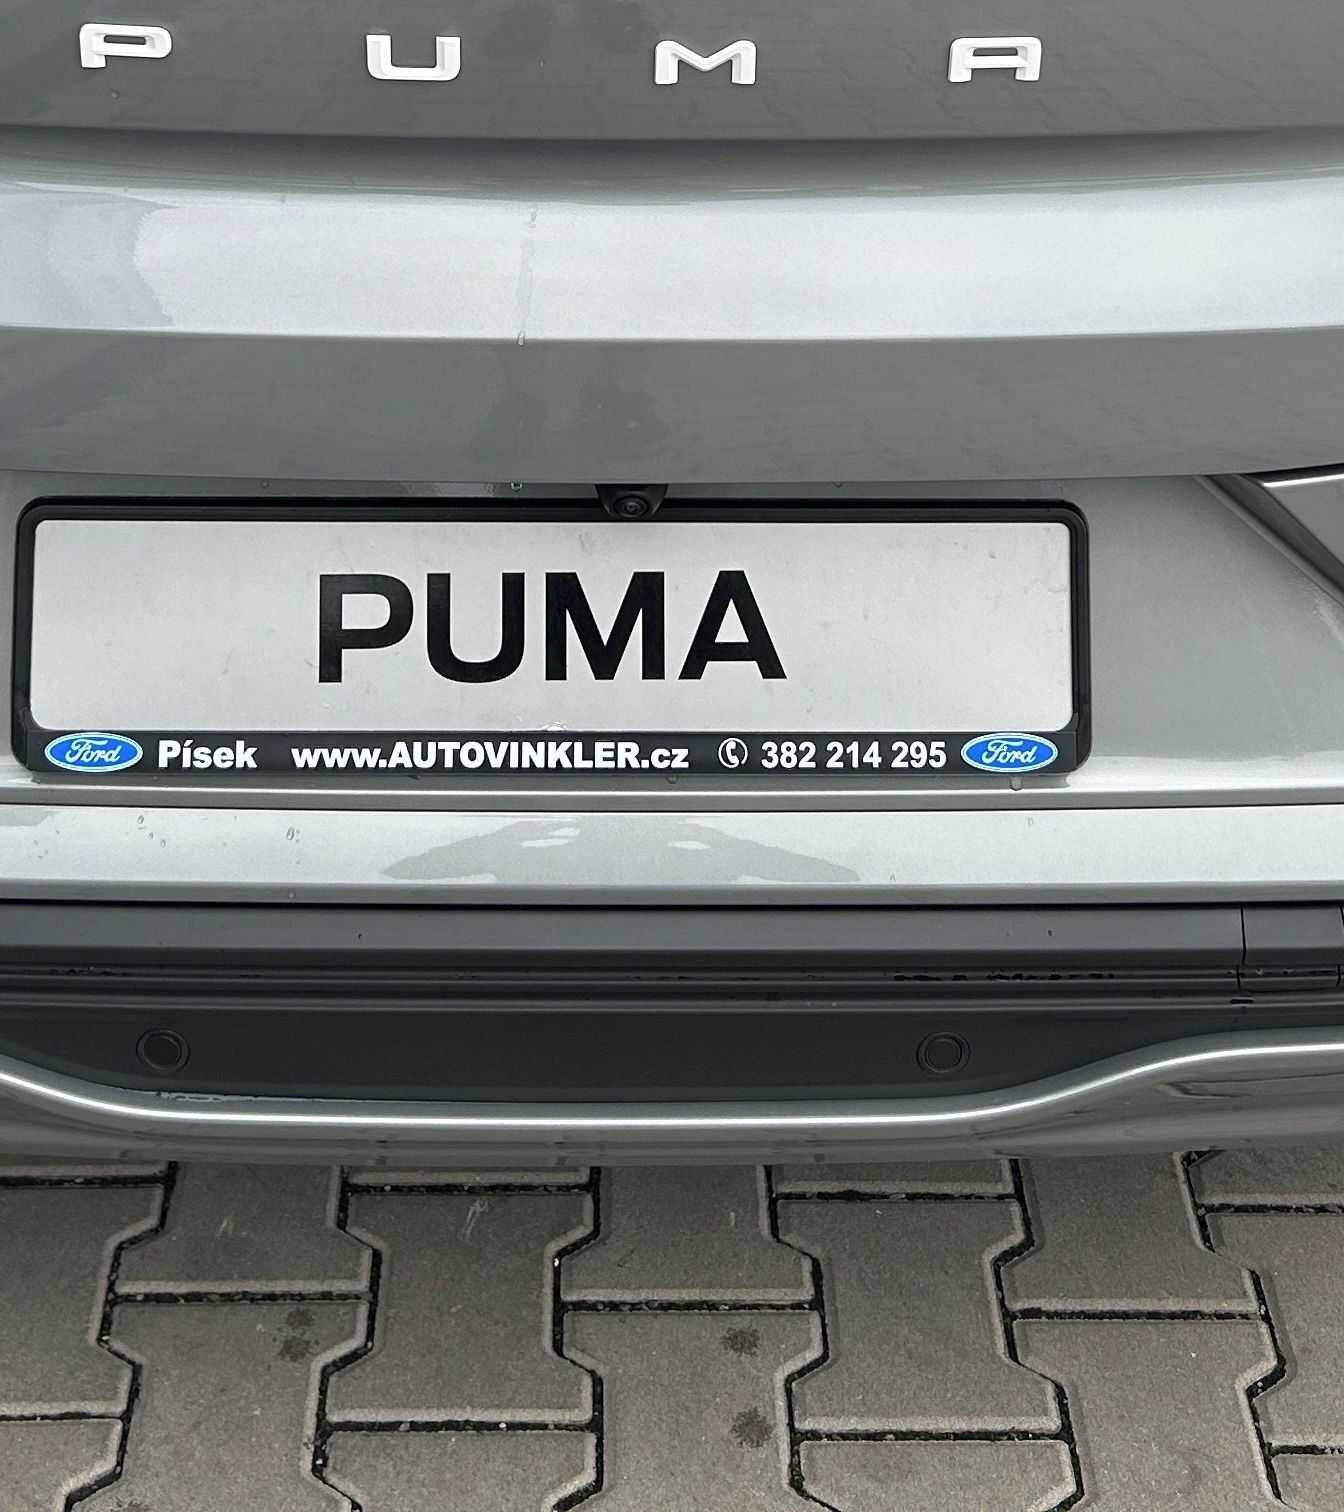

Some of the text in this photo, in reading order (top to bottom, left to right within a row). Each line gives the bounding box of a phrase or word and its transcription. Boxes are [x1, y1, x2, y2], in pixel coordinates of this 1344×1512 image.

[79, 22, 1043, 85] PUMA
[318, 571, 787, 684] PUMA
[64, 738, 1038, 769] Ford Písek www.AUTOVINKLER.cz 382 214 295 Ford
